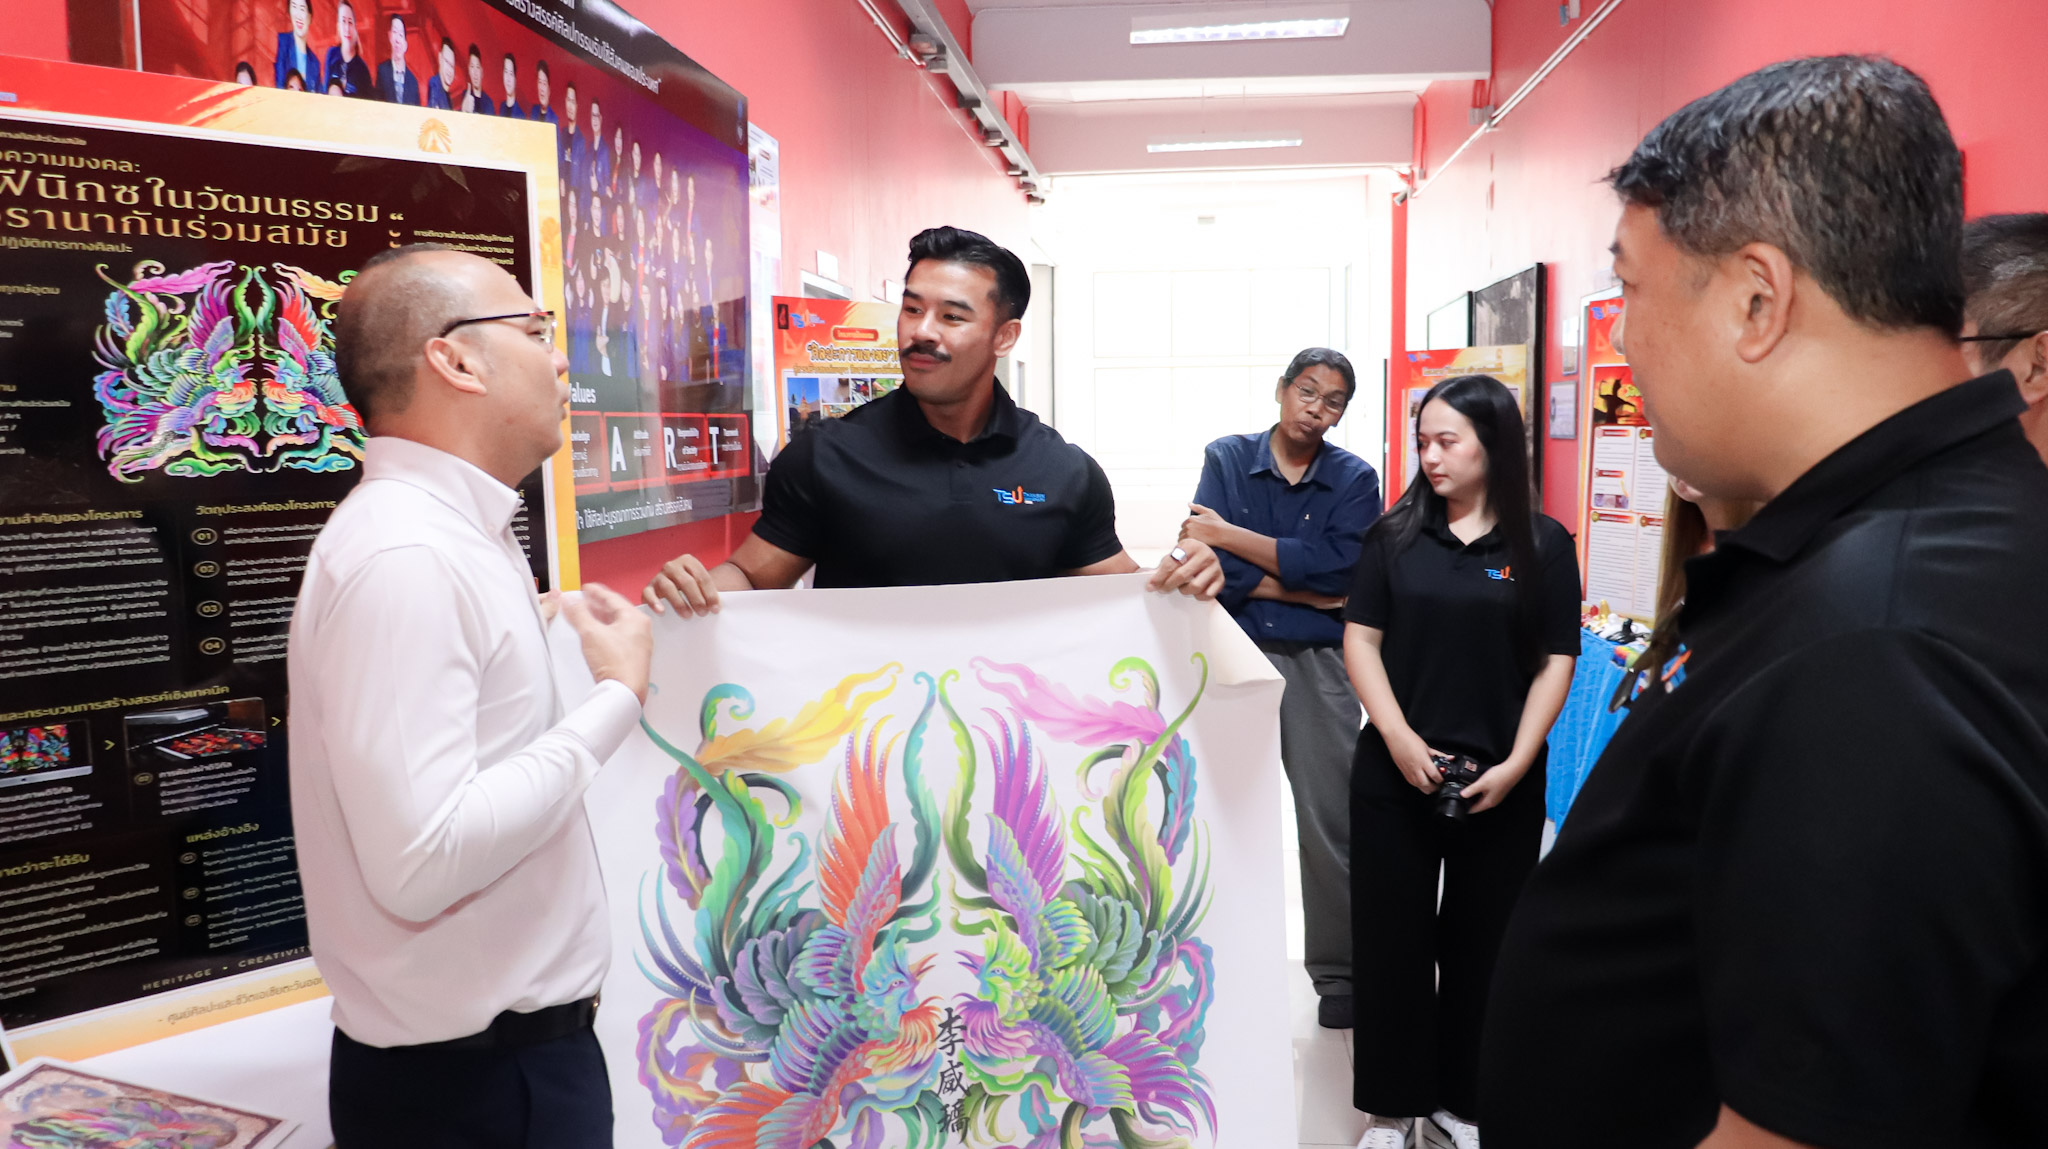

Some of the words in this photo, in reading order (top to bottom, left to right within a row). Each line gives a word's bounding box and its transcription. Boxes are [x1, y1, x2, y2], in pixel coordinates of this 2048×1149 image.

[0, 150, 141, 173] ความมงคล:
[0, 207, 348, 248] รานากันร่วมสมัย
[611, 426, 627, 472] A
[664, 427, 677, 469] R
[708, 426, 719, 465] T
[992, 485, 1023, 505] TSU
[1484, 565, 1511, 580] TSU
[0, 853, 90, 878] าดว่าจะได้รับ
[142, 968, 212, 991] HERITAGE
